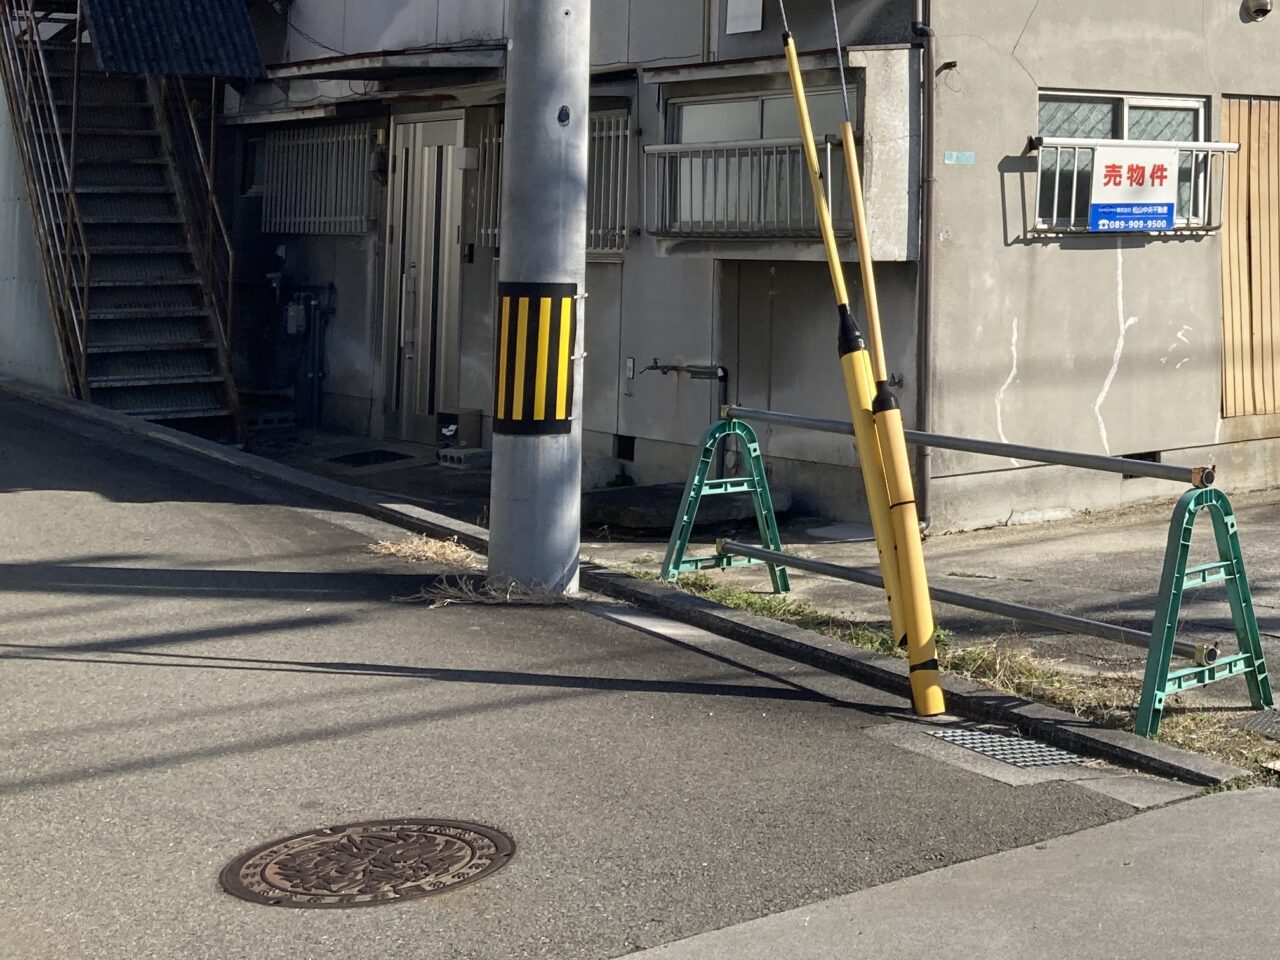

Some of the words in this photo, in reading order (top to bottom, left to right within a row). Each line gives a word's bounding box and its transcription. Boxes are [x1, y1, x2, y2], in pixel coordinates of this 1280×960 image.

[1103, 163, 1168, 187] 売物件
[1109, 220, 1167, 229] 089-909-9500
